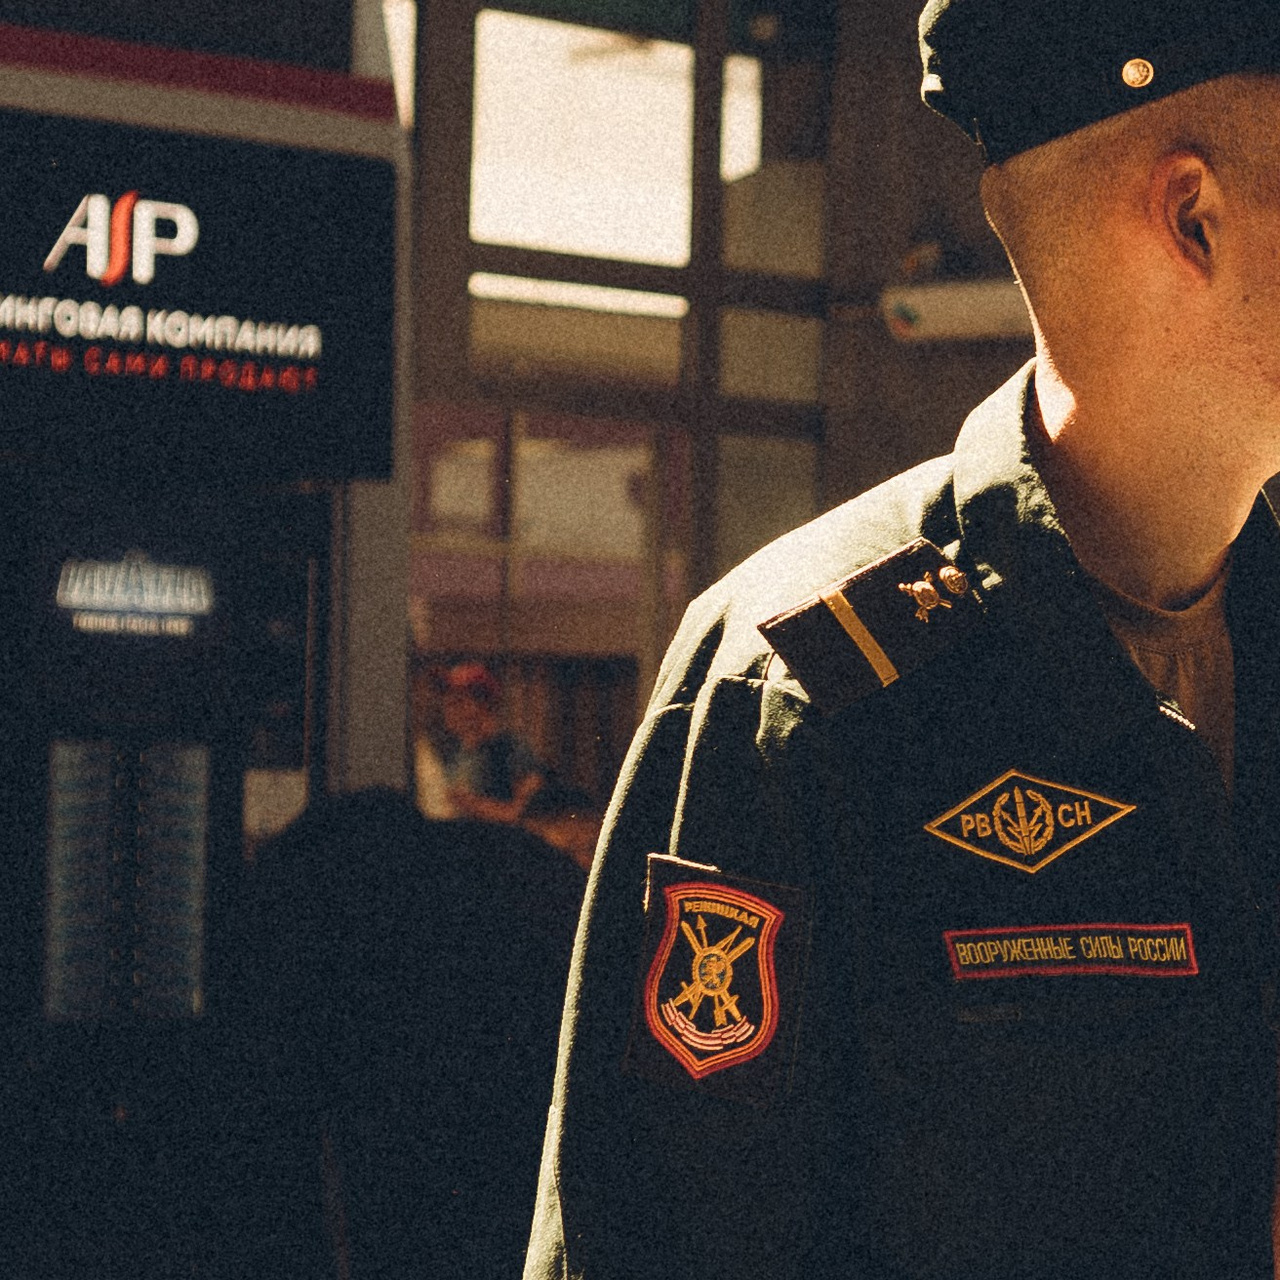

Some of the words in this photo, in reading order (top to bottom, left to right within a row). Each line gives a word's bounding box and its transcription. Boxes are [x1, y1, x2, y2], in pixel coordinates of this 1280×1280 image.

[146, 307, 322, 360] КОМПАНИЯ
[83, 345, 170, 380] САМИ
[179, 354, 319, 394] ПРОДАЮТ
[955, 937, 1077, 966] ВООРУЖЕННЫЕ
[1079, 934, 1124, 959] СИЛЫ
[1127, 936, 1188, 962] РОССИИ
